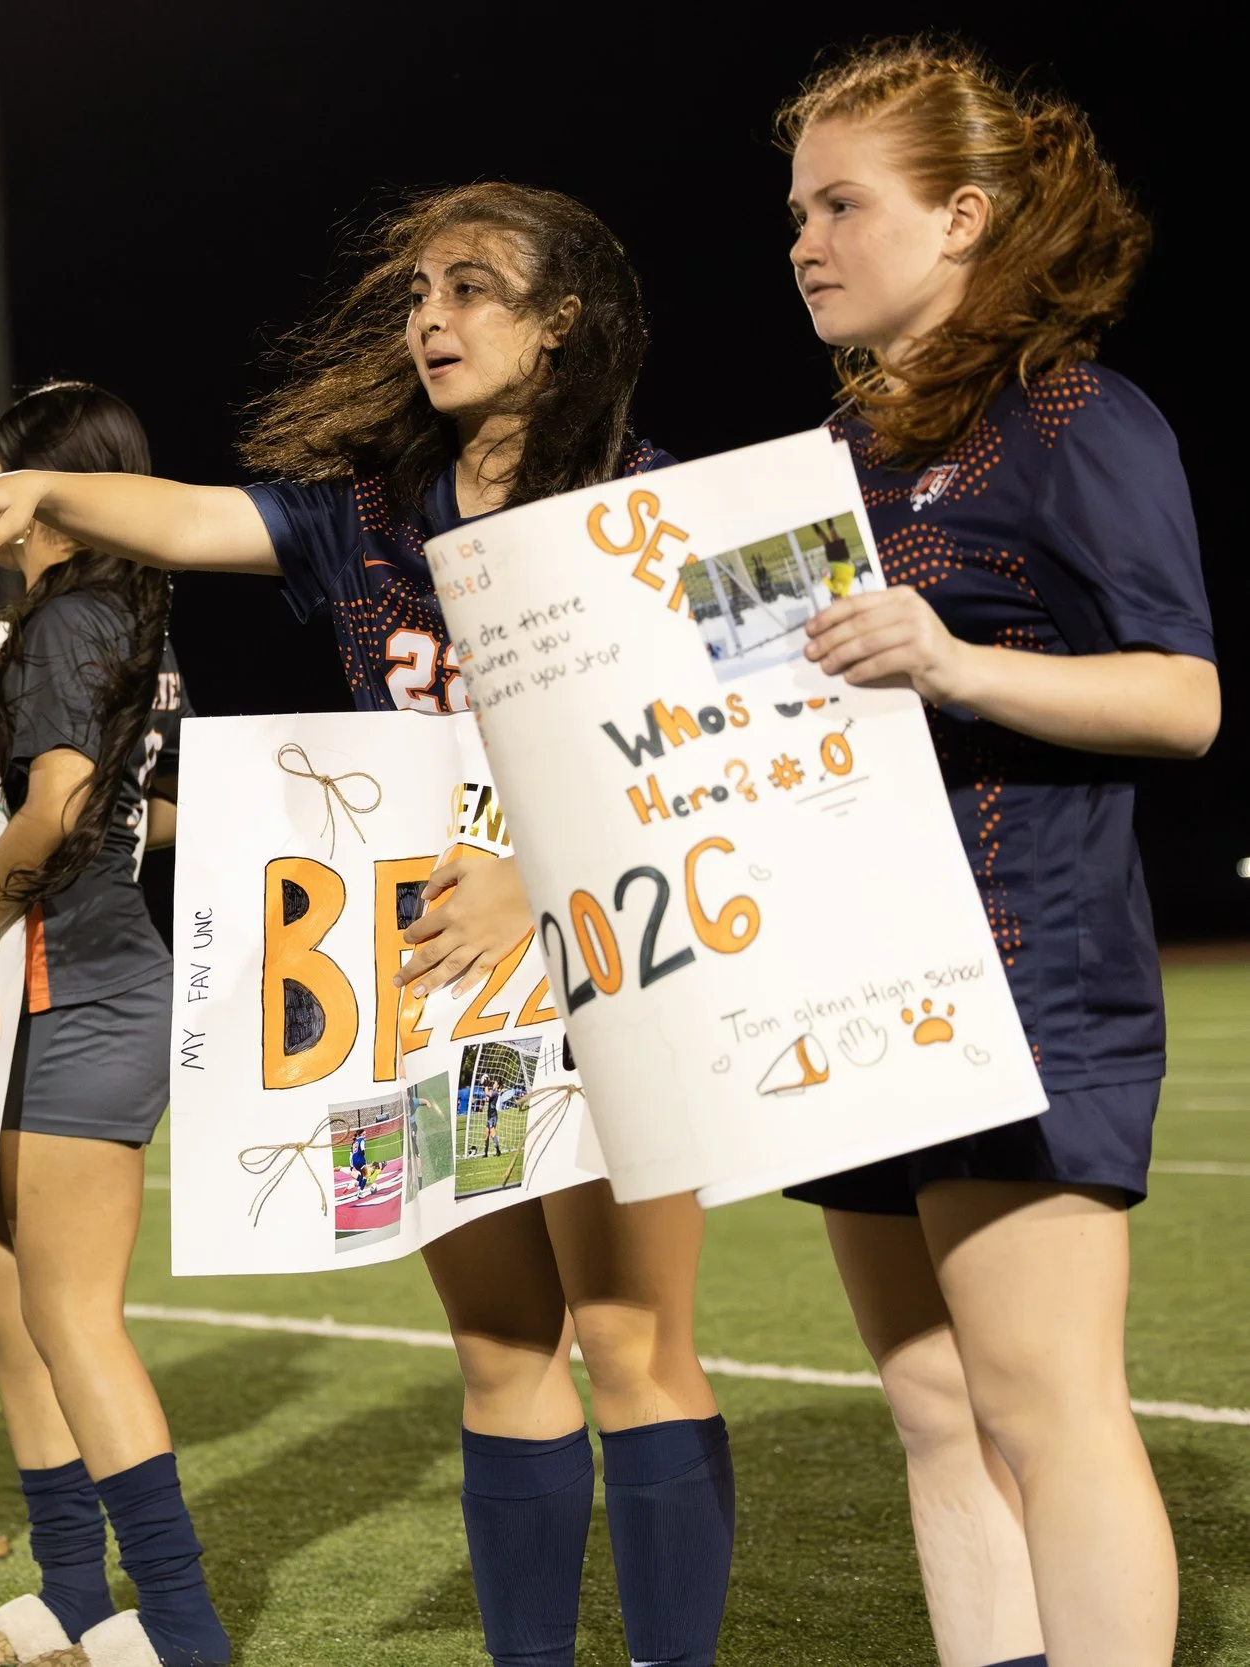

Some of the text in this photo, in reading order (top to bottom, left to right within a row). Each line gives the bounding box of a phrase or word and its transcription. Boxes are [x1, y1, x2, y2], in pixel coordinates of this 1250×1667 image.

[518, 596, 586, 631] there
[476, 630, 571, 676] when you
[481, 679, 526, 710] when
[530, 663, 567, 690] you
[540, 836, 761, 1017] 2026
[180, 907, 213, 1071] MY FAV UNC
[720, 1008, 781, 1044] Tom
[861, 978, 915, 1006] High
